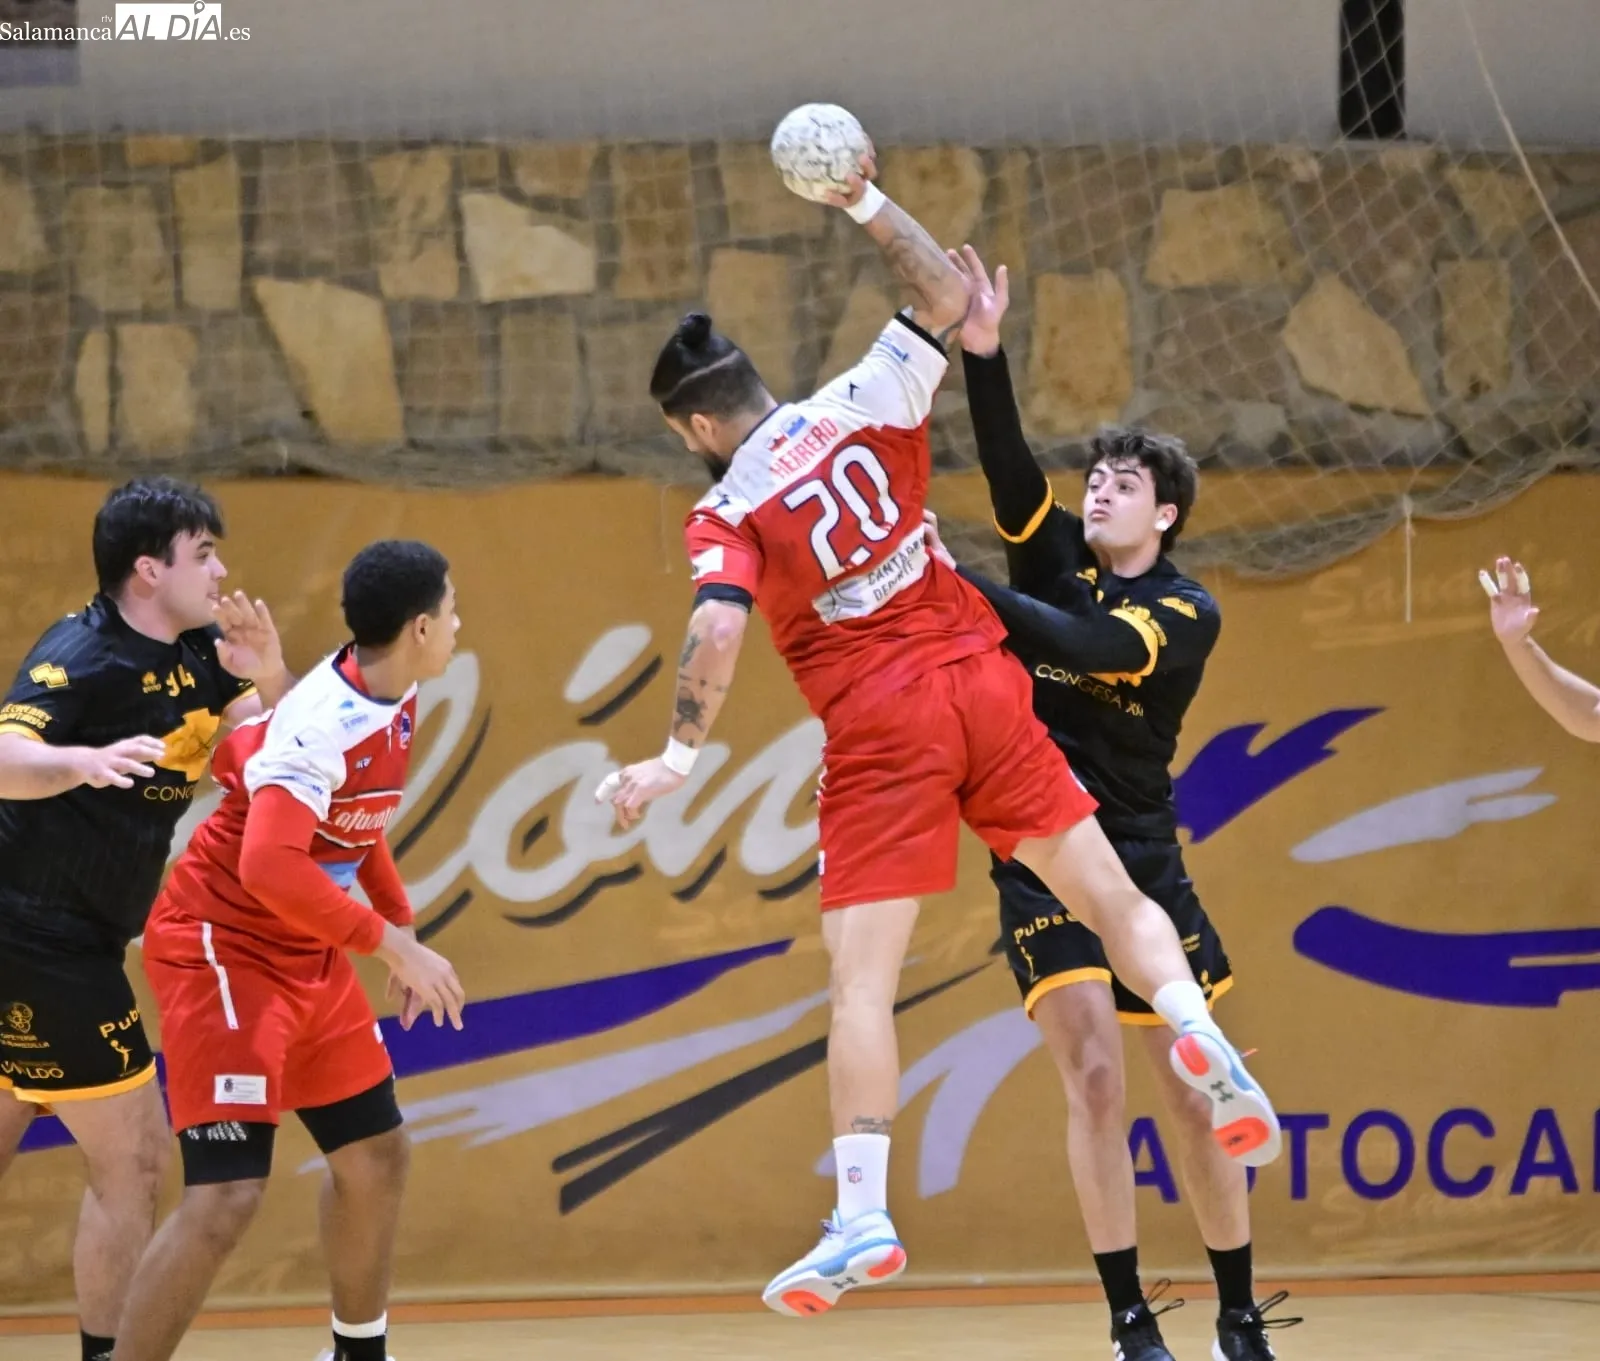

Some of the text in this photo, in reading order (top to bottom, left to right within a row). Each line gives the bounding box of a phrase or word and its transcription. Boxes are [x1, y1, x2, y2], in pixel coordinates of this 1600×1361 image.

[769, 417, 839, 480] HERRERO
[781, 443, 901, 581] 20
[1035, 663, 1123, 709] CONGESA
[326, 805, 397, 833] afuent
[1127, 1107, 1600, 1204] ATOCA
